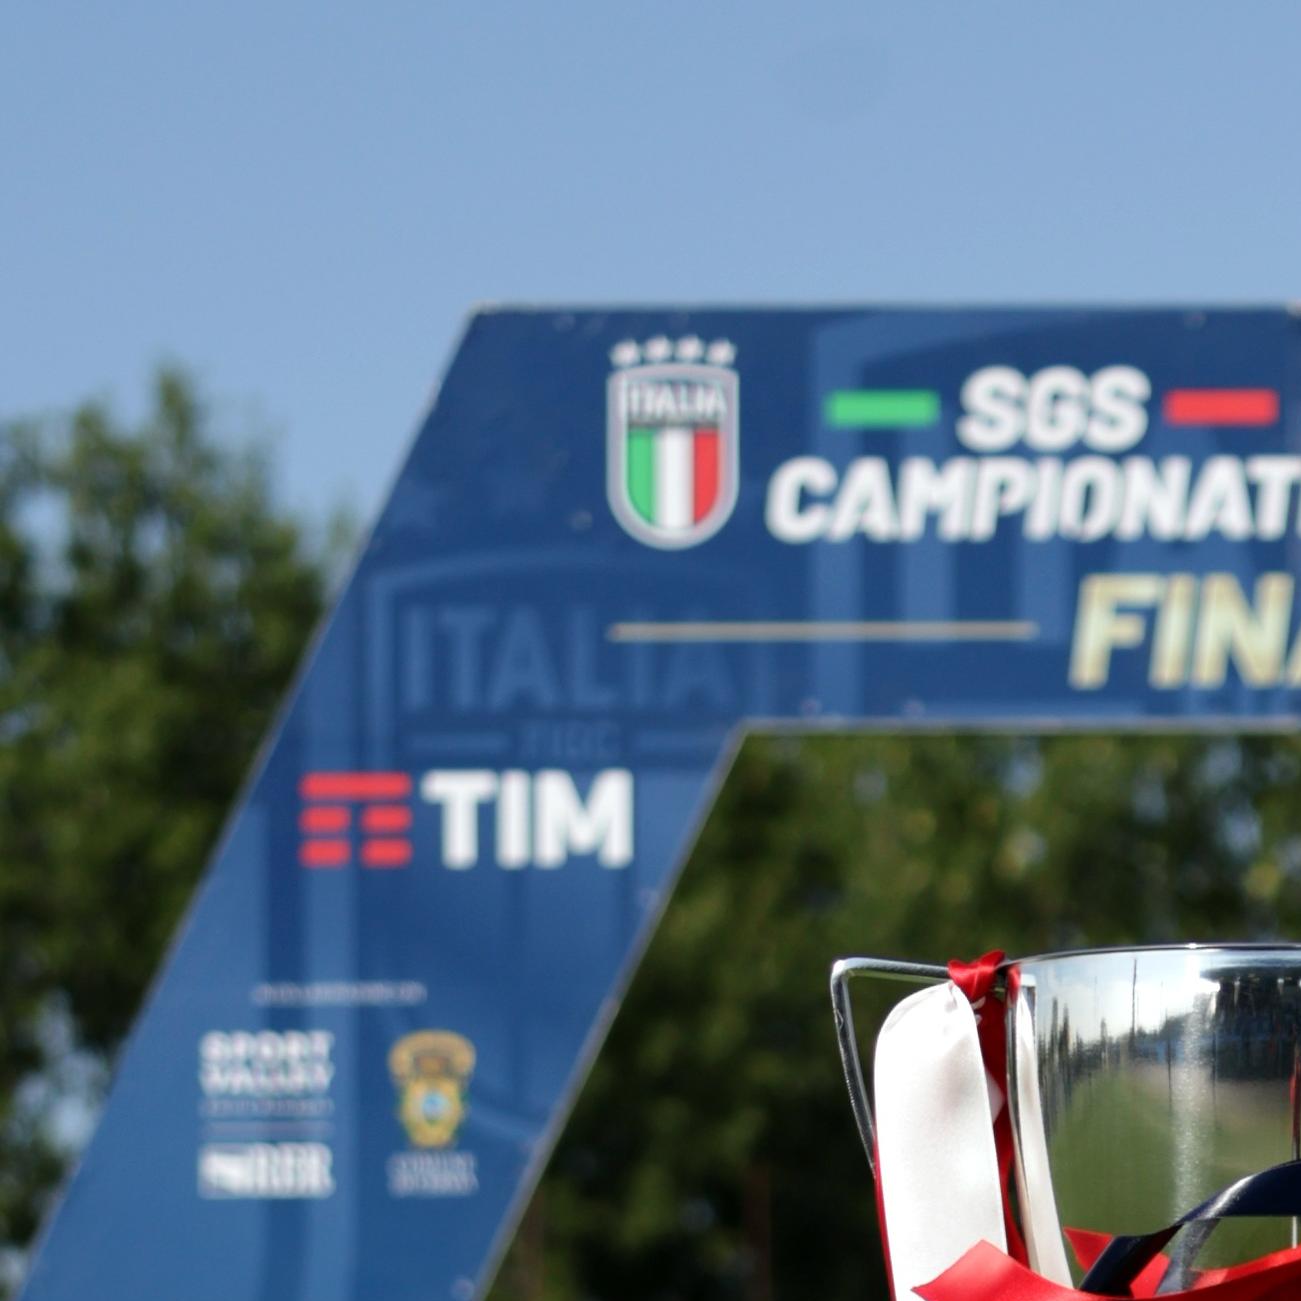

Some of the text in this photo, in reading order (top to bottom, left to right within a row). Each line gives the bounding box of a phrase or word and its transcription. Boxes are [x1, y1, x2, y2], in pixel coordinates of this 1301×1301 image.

[628, 384, 728, 420] ITALIA
[956, 364, 1151, 452] SGS
[420, 768, 634, 870] TIM
